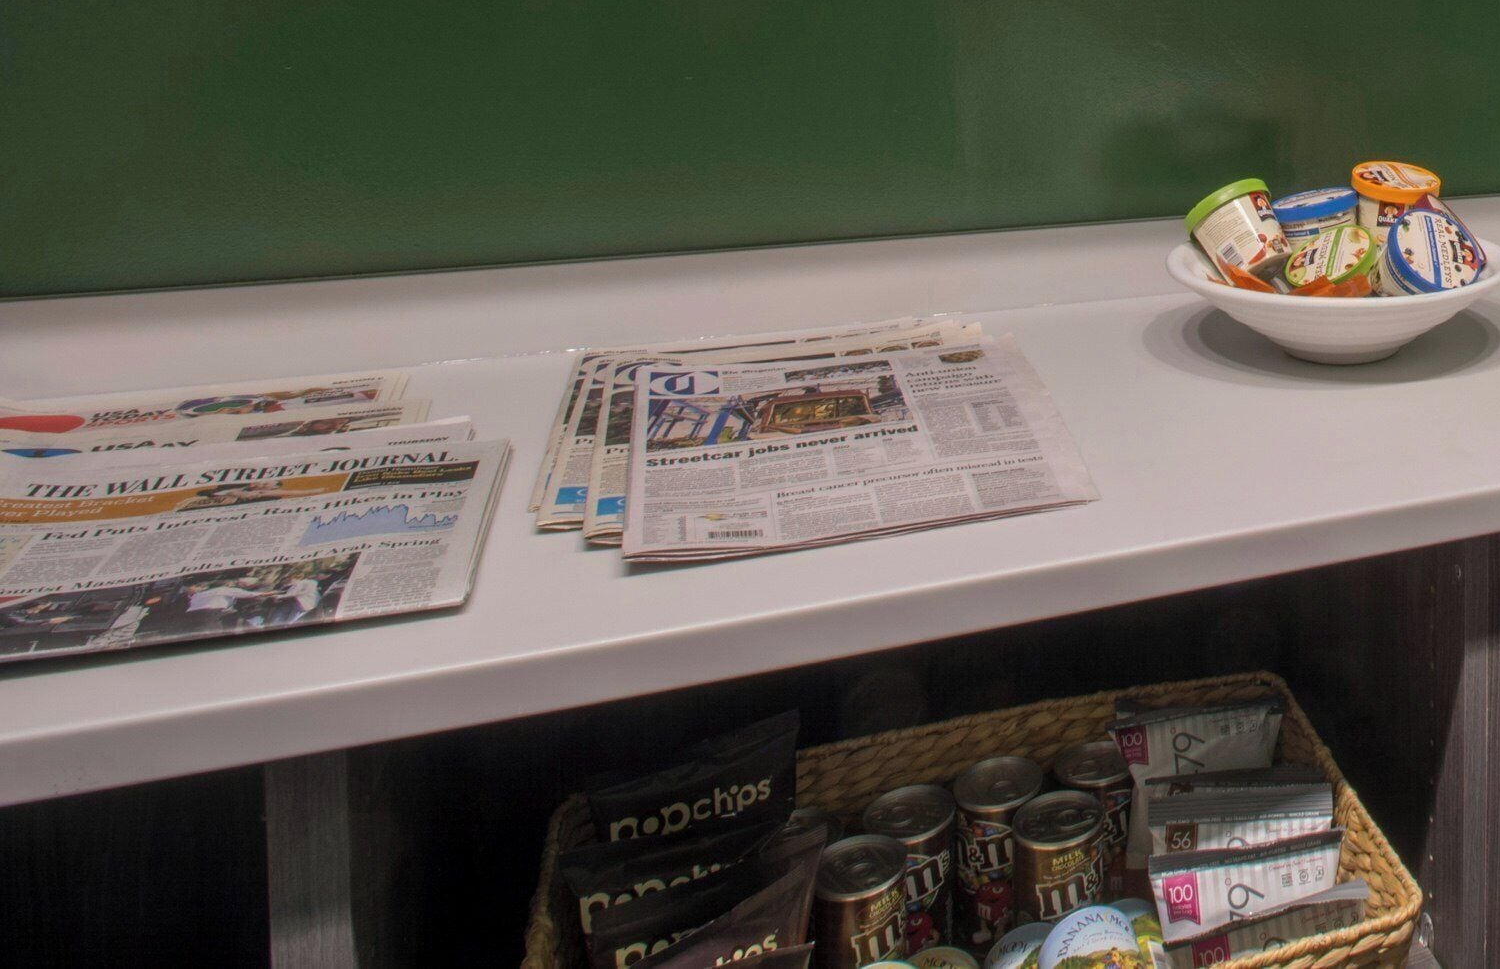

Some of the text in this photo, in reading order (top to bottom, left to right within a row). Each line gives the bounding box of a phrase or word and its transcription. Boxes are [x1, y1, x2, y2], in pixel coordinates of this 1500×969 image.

[1434, 217, 1452, 288] REAL MEDLEYS
[89, 408, 174, 423] TODAY
[93, 409, 139, 418] USA
[92, 440, 156, 452] USA
[387, 436, 450, 446] THURSDAY
[646, 450, 744, 468] Streetcar
[748, 442, 791, 459] jobs
[795, 434, 848, 449] never
[853, 424, 919, 441] arrived
[24, 483, 98, 498] THE
[105, 474, 196, 496] WALL
[198, 459, 318, 485] STREET
[776, 487, 815, 498] Breast
[818, 481, 858, 493] cancer
[863, 471, 920, 486] precursor
[923, 466, 954, 476] often
[1017, 455, 1044, 464] tests
[0, 496, 156, 509] reatest Bracket
[32, 506, 104, 520] Played
[41, 530, 88, 541] Fed
[93, 524, 149, 537] Puts
[321, 494, 387, 510] Hikes
[392, 491, 414, 500] in
[419, 488, 468, 501] Play
[0, 537, 441, 595] ourist Massacre Jolts Cradle of Arab Spring
[1121, 732, 1143, 747] 100
[1170, 833, 1192, 849] 56
[1052, 849, 1083, 866] MILK
[870, 887, 899, 913] MILK
[1168, 883, 1193, 904] 100
[1056, 912, 1105, 959] BANANA
[1199, 946, 1225, 968] 100
